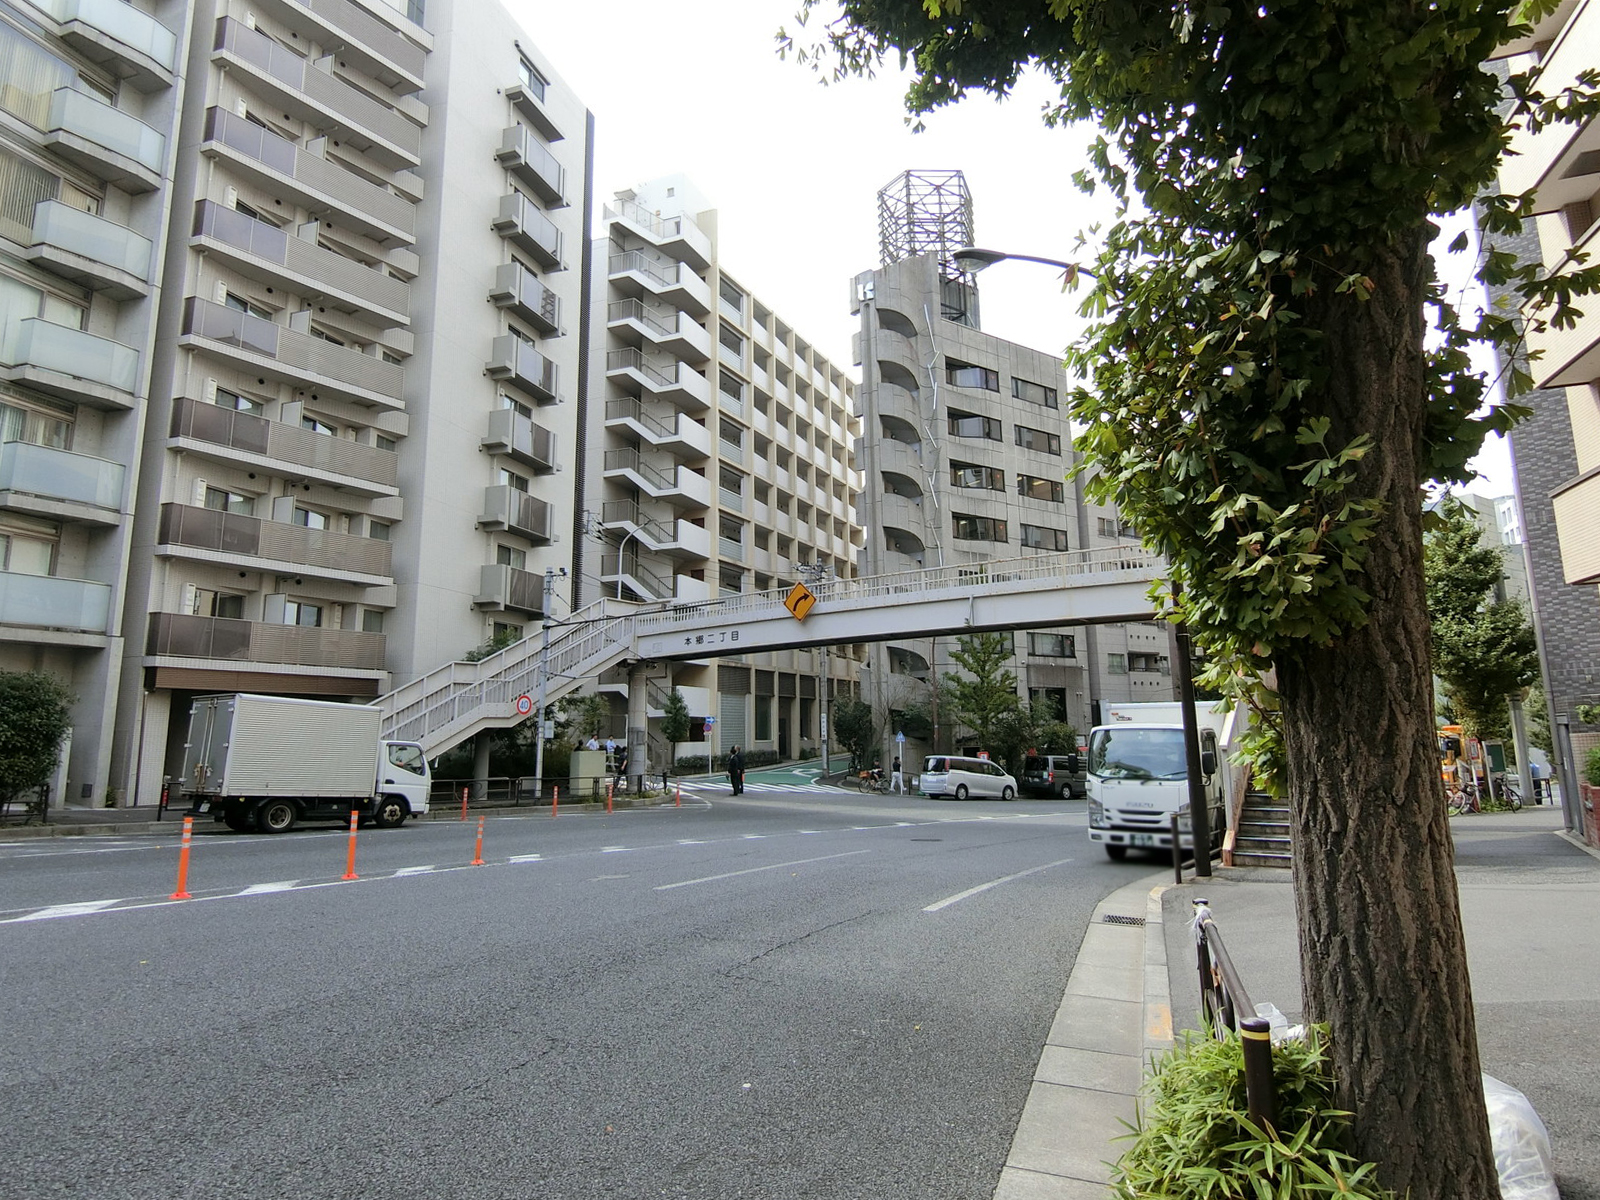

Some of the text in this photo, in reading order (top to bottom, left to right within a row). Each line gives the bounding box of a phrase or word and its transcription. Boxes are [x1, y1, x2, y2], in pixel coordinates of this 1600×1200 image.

[684, 630, 740, 646] 本郷二丁目
[519, 700, 529, 710] 40
